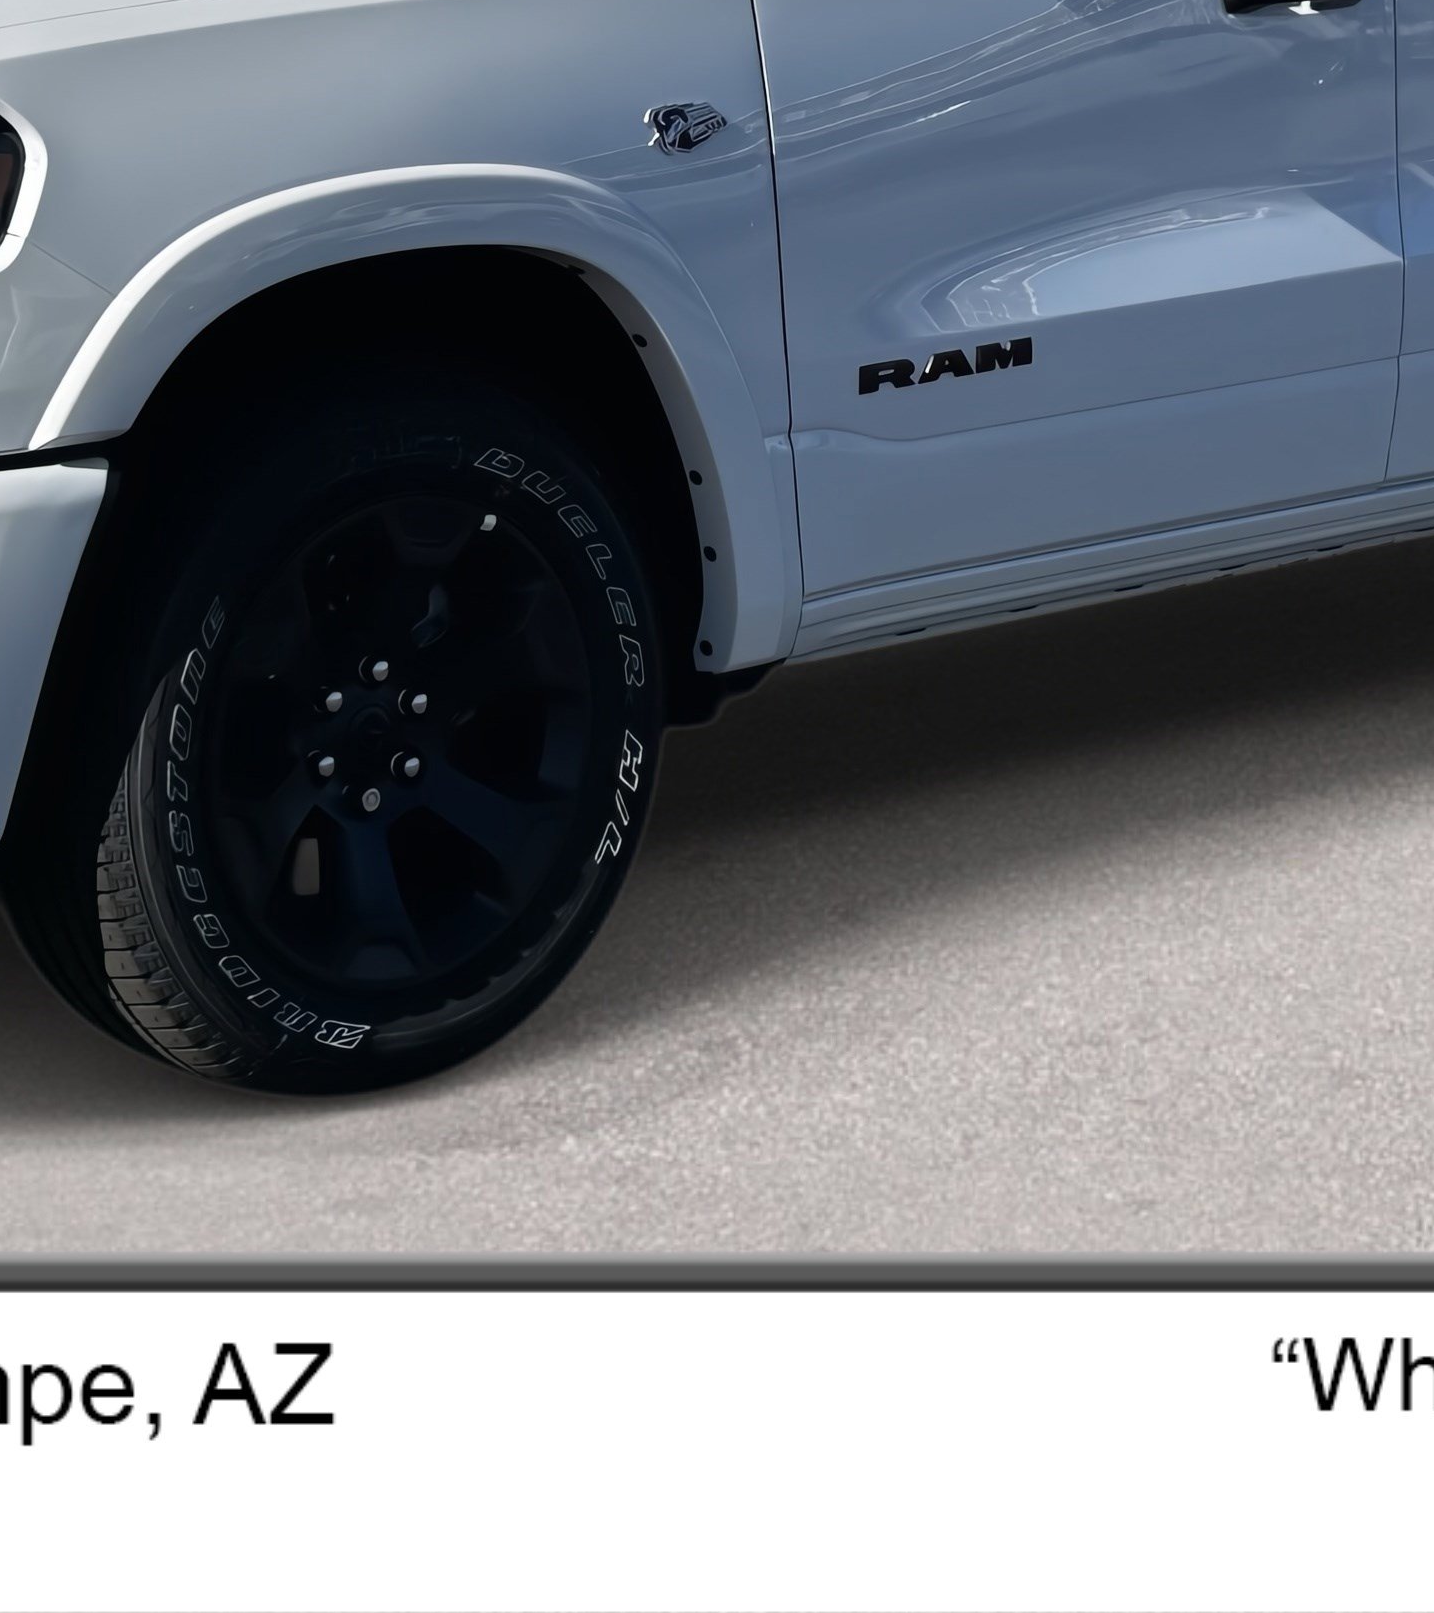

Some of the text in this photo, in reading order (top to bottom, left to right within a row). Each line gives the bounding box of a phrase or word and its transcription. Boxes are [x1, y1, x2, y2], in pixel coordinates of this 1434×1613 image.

[858, 337, 1033, 394] RAM
[474, 448, 645, 690] DUELER
[166, 595, 371, 1049] BRIDGESTONE
